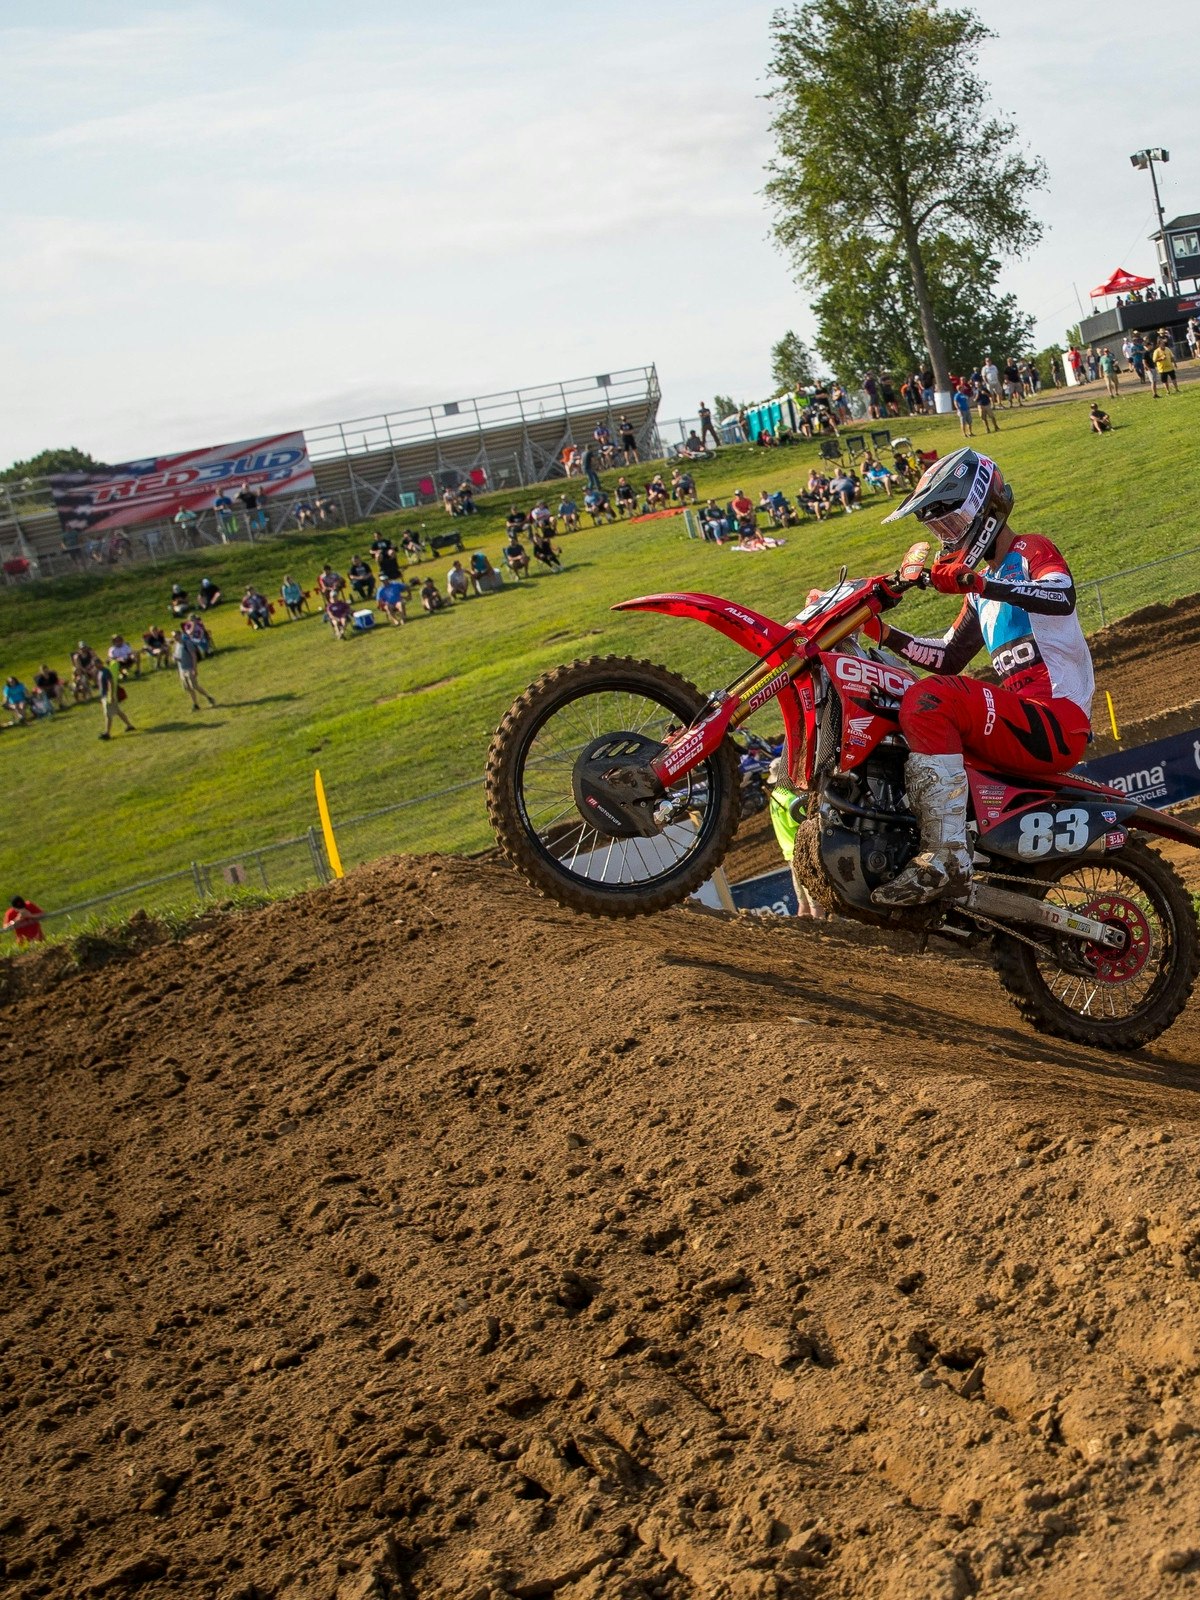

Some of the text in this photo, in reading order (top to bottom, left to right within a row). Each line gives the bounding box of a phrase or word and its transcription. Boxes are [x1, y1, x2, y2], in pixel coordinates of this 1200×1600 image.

[92, 449, 304, 504] REDBUD
[963, 516, 997, 569] GEICO
[901, 641, 945, 669] SHIFT
[750, 671, 790, 713] SHOWA
[982, 687, 996, 736] GEICO
[664, 730, 705, 768] DUNLOP
[847, 728, 872, 741] HONDA
[1058, 772, 1102, 789] ONDA
[597, 804, 622, 827] MOTOSTUFF
[1017, 808, 1090, 858] 83
